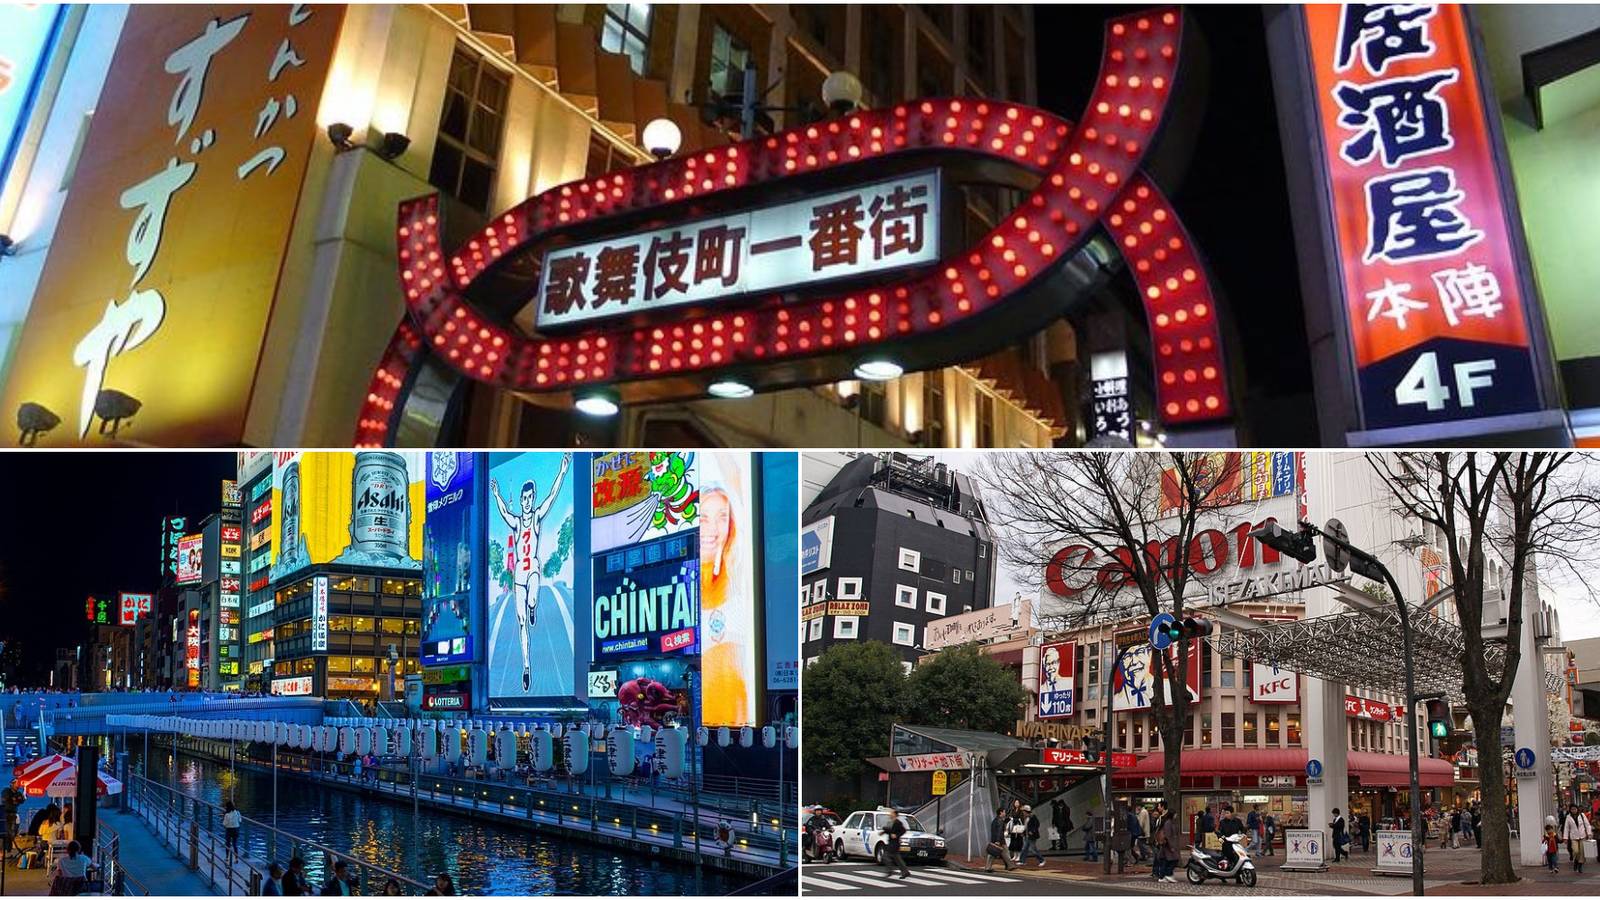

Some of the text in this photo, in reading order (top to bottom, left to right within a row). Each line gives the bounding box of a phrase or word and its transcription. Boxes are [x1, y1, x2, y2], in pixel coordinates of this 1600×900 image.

[1333, 4, 1485, 265] 居酒屋
[73, 13, 250, 441] すずや
[543, 185, 929, 315] 歌舞伎町一番街
[1365, 262, 1503, 331] 本陣
[1395, 351, 1497, 411] 4F
[357, 487, 404, 513] Asahi
[374, 516, 388, 526] 生
[522, 528, 531, 571] グリコ
[1046, 516, 1281, 597] Canon
[595, 579, 695, 639] CHINTAI
[673, 633, 690, 645] 検索
[434, 698, 460, 706] LOTTERIA
[1259, 678, 1290, 696] KFC
[1017, 720, 1105, 742] MARINAR
